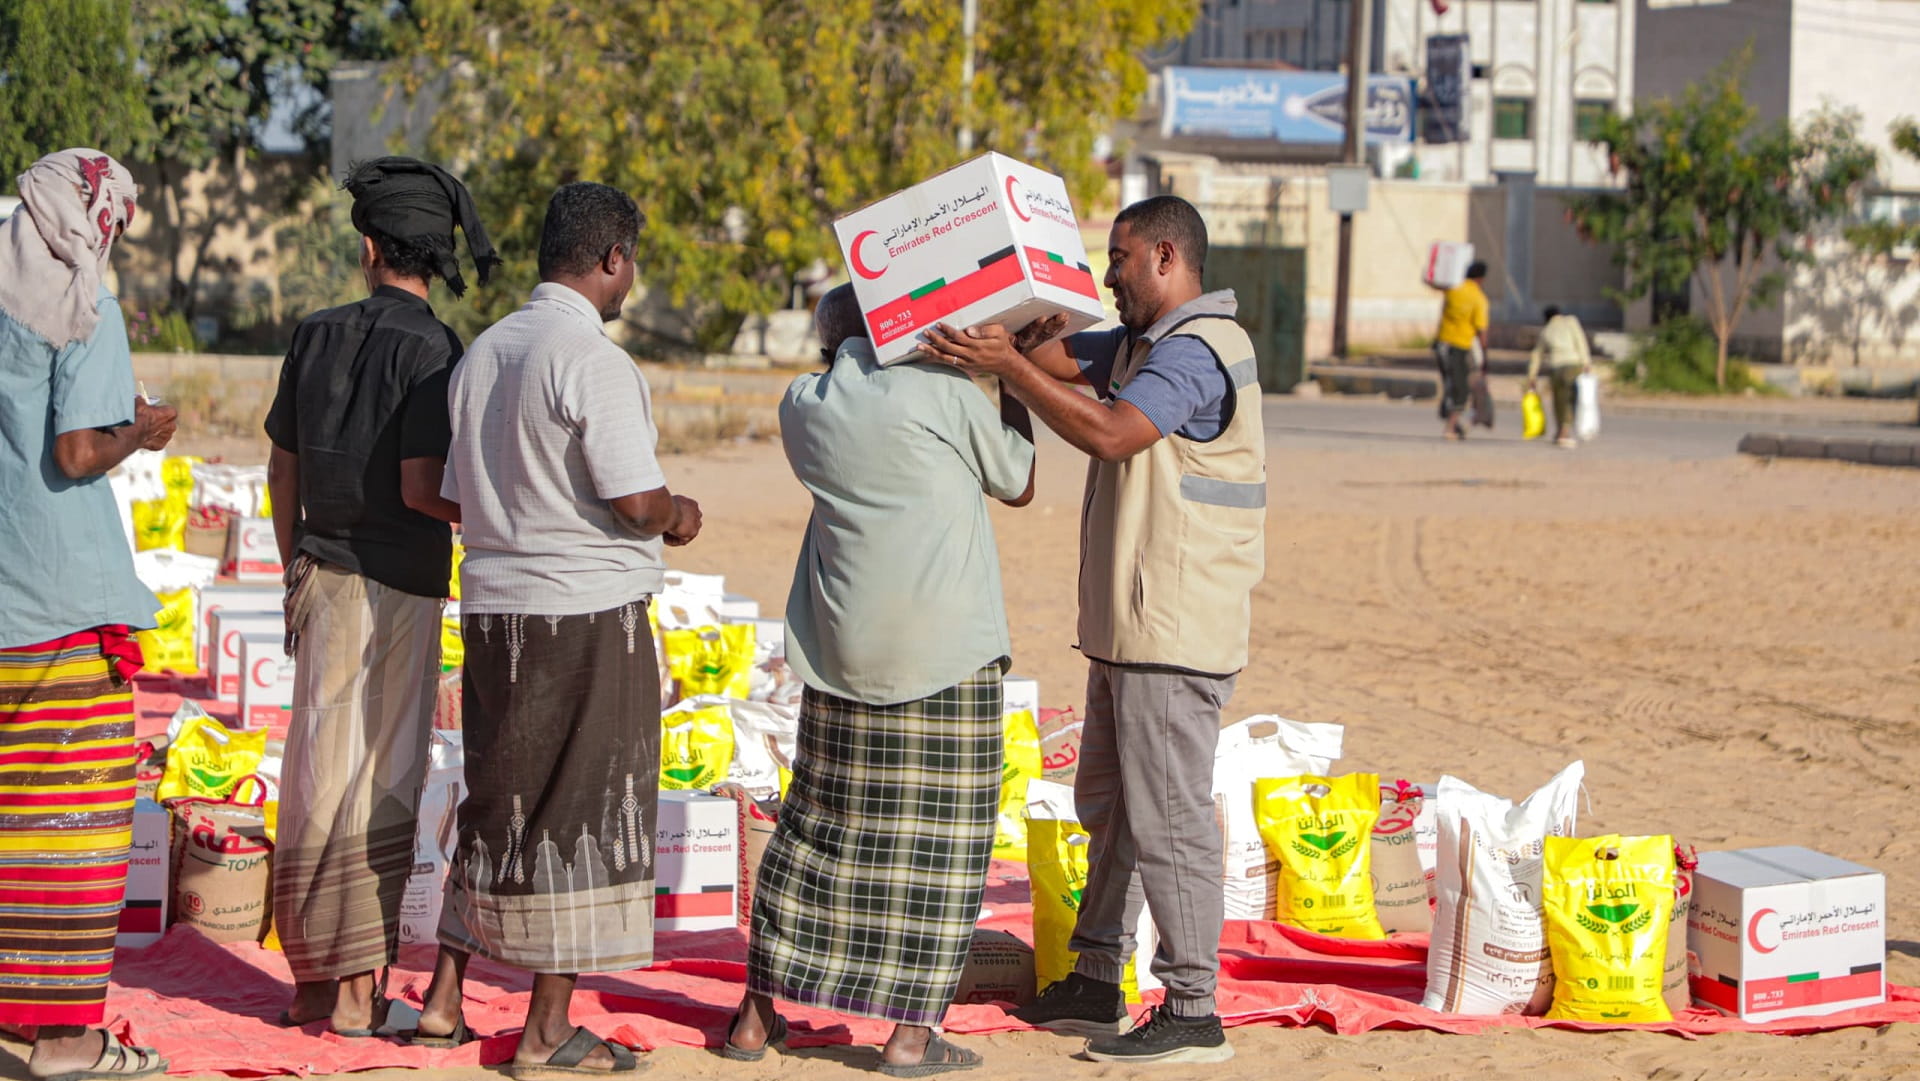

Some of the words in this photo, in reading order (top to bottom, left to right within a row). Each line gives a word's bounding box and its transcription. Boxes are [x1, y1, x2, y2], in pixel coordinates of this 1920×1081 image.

[888, 233, 931, 258] Emirates
[932, 222, 952, 238] Red
[953, 201, 998, 227] Crescent
[672, 844, 691, 853] Red
[692, 843, 732, 853] Crescent
[128, 856, 161, 865] escent
[1782, 929, 1820, 941] Emirates
[1822, 924, 1840, 935] Red
[1841, 920, 1880, 932] Crescent
